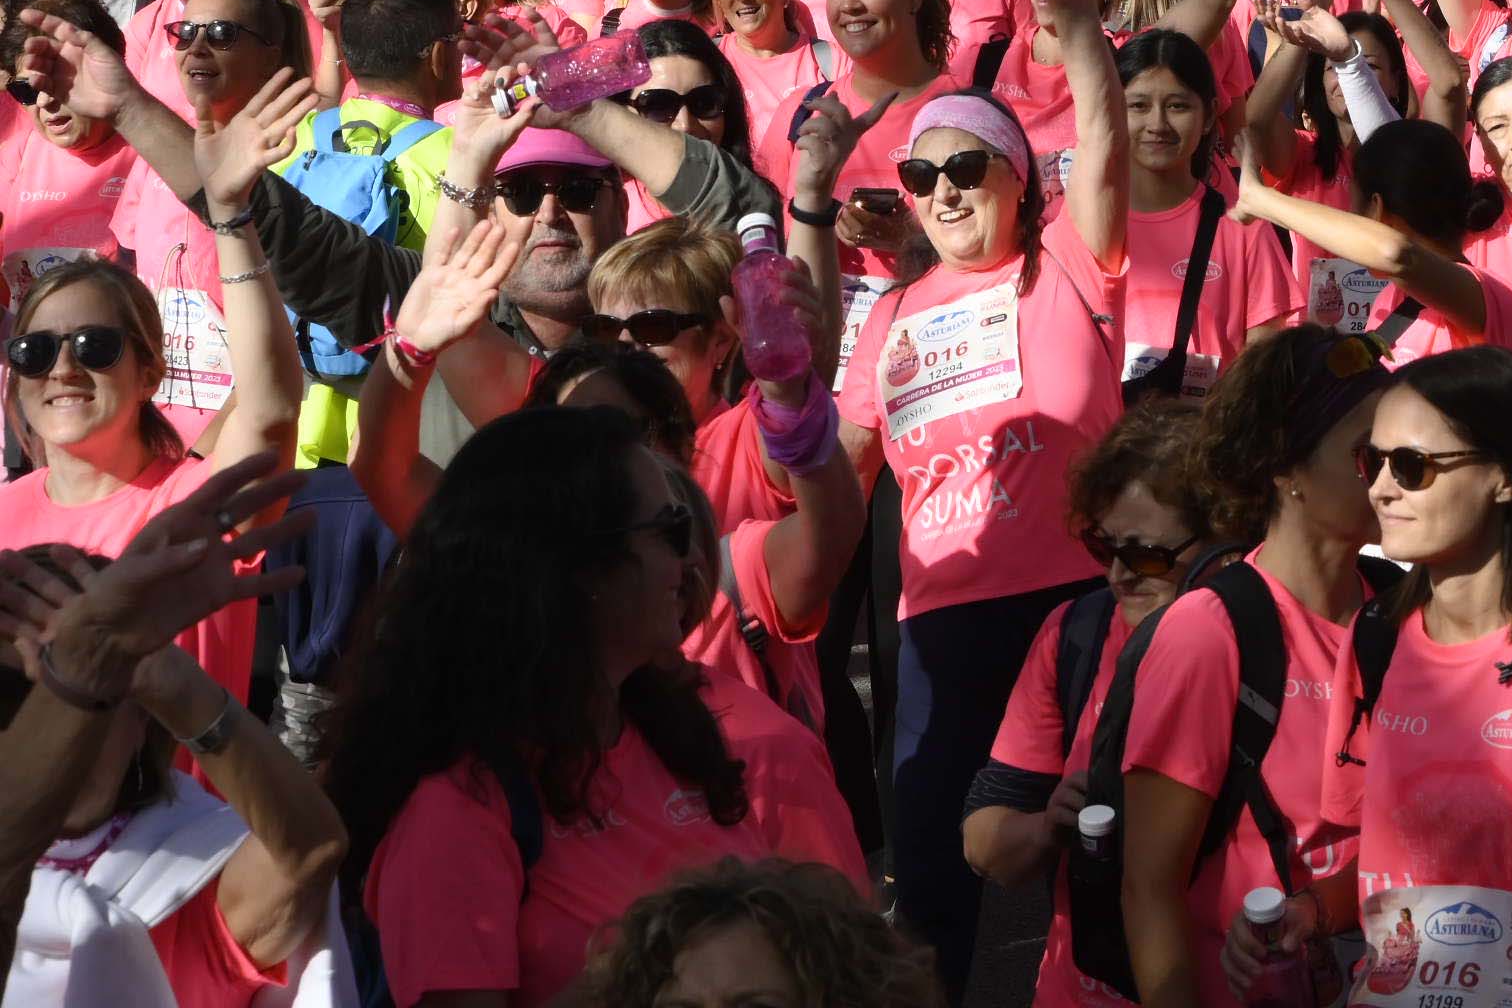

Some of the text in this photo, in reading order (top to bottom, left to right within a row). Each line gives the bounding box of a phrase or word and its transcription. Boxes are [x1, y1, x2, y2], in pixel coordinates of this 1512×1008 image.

[1347, 302, 1372, 317] 01
[924, 341, 969, 368] 016
[929, 361, 964, 382] 12294
[896, 387, 930, 407] CARRERA
[931, 381, 943, 393] DE
[920, 478, 1013, 529] SUMA
[1430, 919, 1497, 939] ASTURIANA
[1419, 960, 1481, 988] 016
